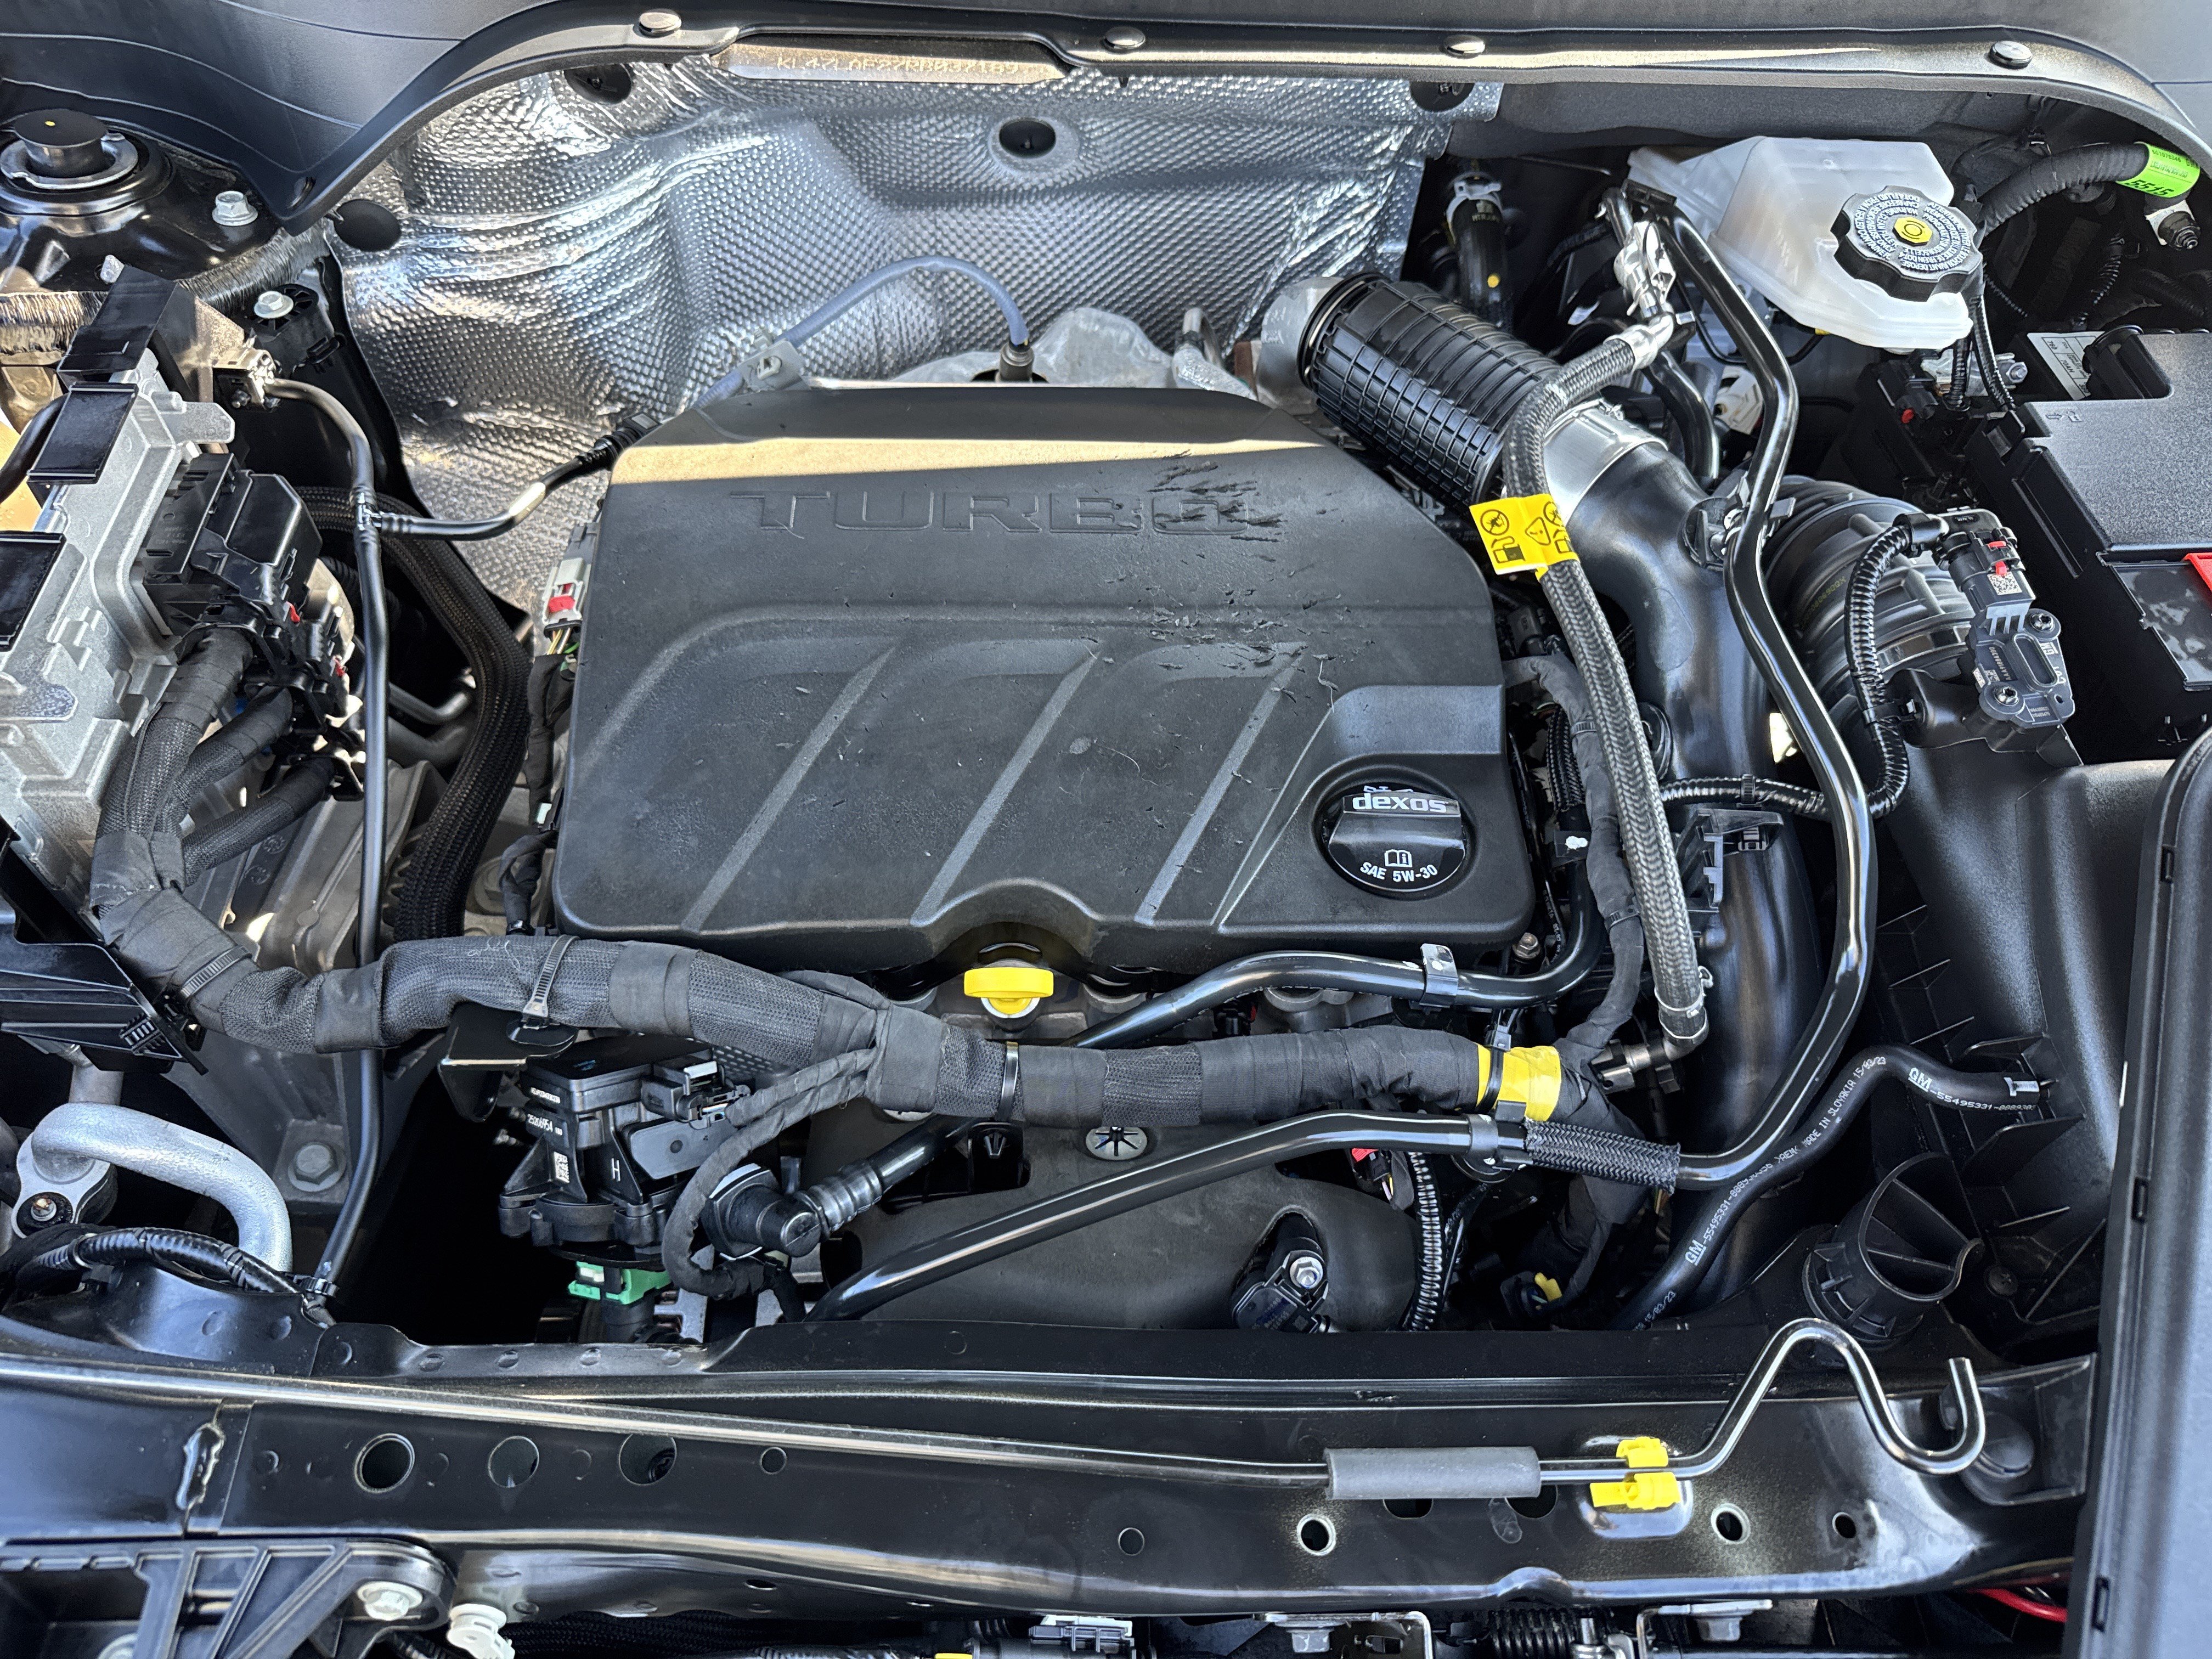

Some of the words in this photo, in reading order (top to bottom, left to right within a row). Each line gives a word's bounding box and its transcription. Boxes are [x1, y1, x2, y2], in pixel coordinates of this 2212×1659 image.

[2124, 179, 2175, 195] 5515
[730, 489, 1249, 535] TURBO
[1359, 861, 1387, 880] SAE
[1392, 864, 1438, 882] 5W-30
[1801, 1129, 1822, 1148] MADE
[1819, 1116, 1831, 1129] IN
[1827, 1079, 1857, 1117] SLOVAKIA
